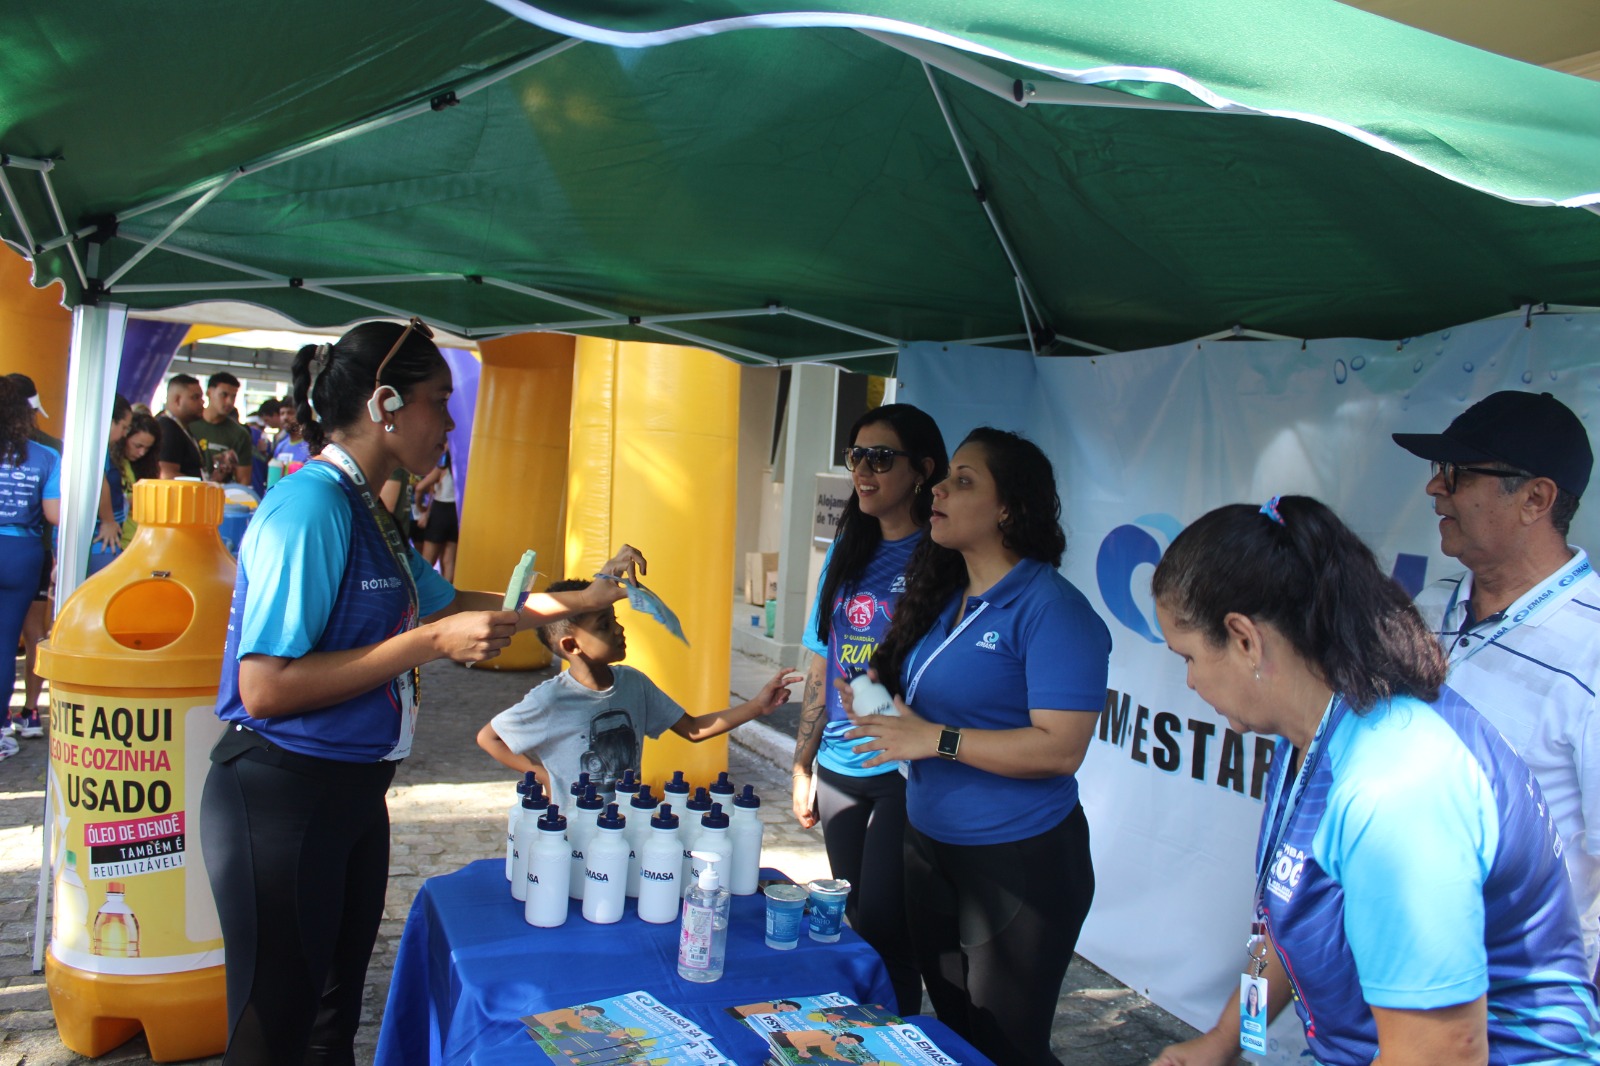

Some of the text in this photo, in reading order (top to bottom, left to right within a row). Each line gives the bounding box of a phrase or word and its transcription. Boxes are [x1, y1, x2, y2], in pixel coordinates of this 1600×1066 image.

[816, 512, 826, 524] de
[361, 577, 389, 591] ROTA
[1528, 589, 1554, 611] EMASA
[853, 613, 867, 625] 15
[840, 642, 879, 664] RUN
[975, 640, 996, 651] EMASA
[90, 706, 172, 748] AQUI
[63, 742, 79, 767] DE
[81, 746, 172, 772] COZINHA
[67, 773, 172, 814] USADO
[88, 813, 181, 844] ÓLEO DE DENDÊ
[120, 836, 183, 860] TAMBÉM É
[93, 855, 183, 878] REUTILIZÁVEL!
[643, 869, 675, 881] EMASA
[651, 1005, 691, 1029] EMASA
